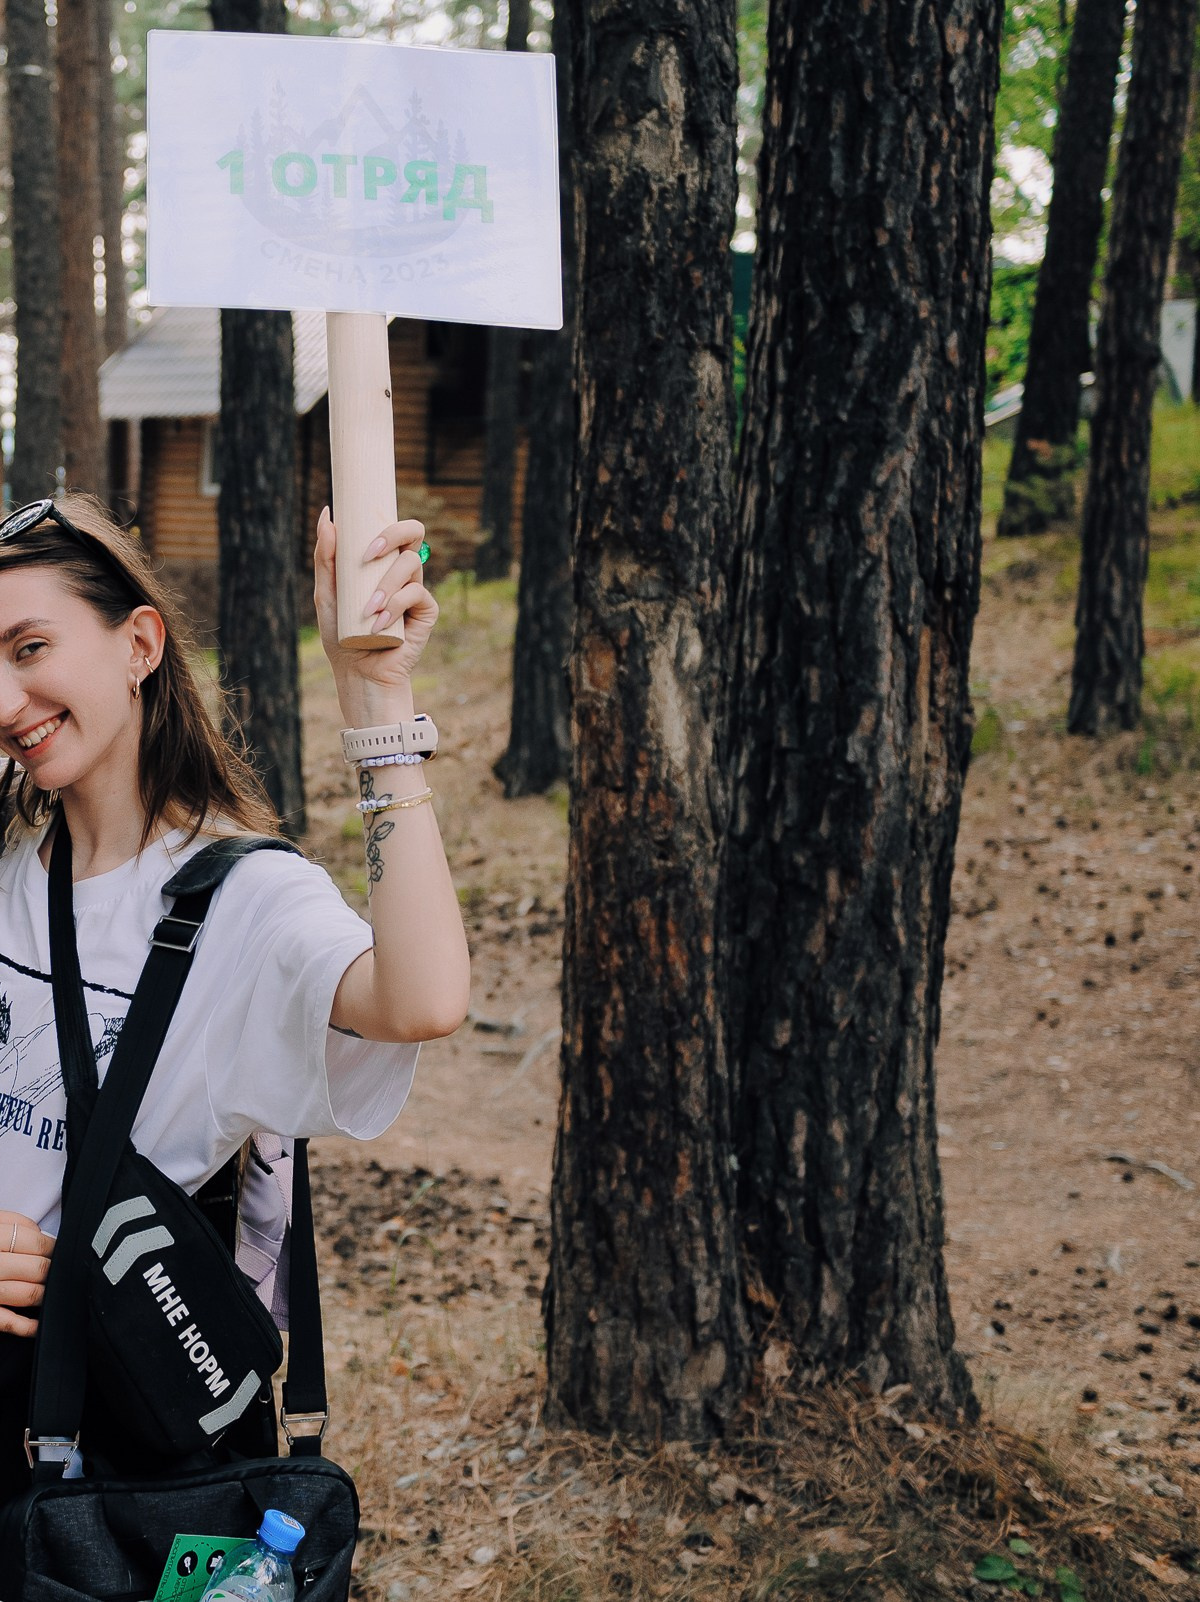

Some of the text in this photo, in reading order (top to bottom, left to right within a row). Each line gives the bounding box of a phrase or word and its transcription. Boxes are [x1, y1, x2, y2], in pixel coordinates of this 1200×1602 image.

[216, 149, 494, 223] 1 ОТРЯД
[259, 239, 450, 286] СМЕНА 2023
[142, 1262, 231, 1398] МНЕ НОРМ
